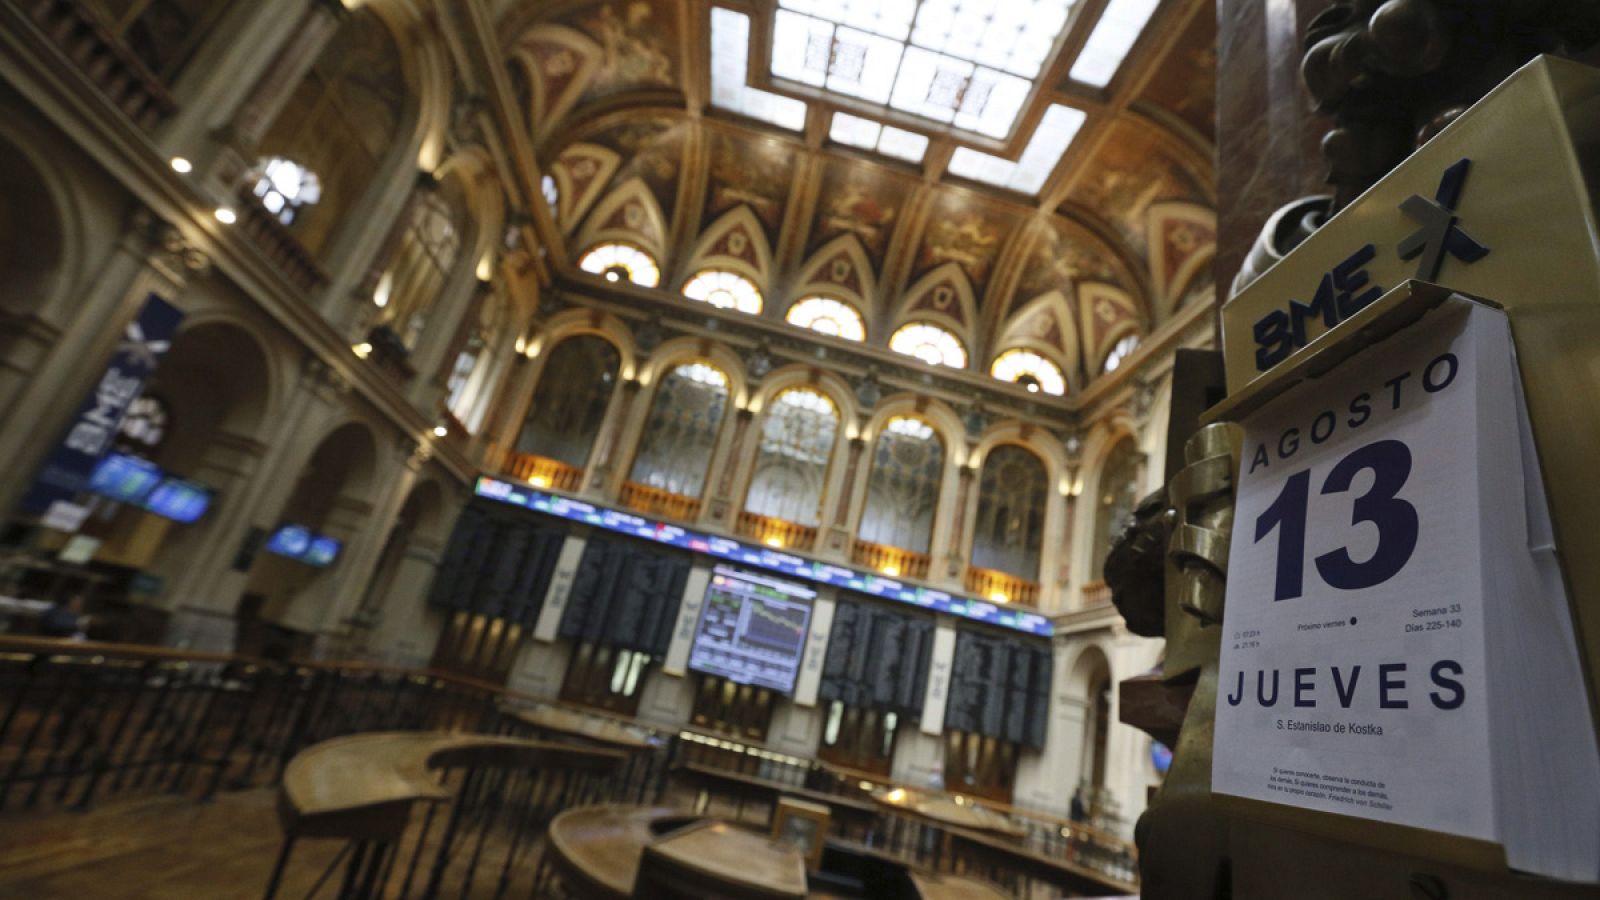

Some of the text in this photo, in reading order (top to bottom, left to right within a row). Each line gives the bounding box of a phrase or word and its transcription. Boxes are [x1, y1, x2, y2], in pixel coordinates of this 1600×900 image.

[1253, 243, 1384, 372] BME
[1249, 353, 1459, 475] AGOSTO
[1254, 439, 1419, 601] 13
[1405, 618, 1462, 633] Días 225-140
[1412, 603, 1461, 618] Semana 33
[1228, 660, 1465, 710] JUEVES
[1277, 719, 1383, 736] S. Estanislao de Kostka
[1351, 778, 1376, 788] conducta
